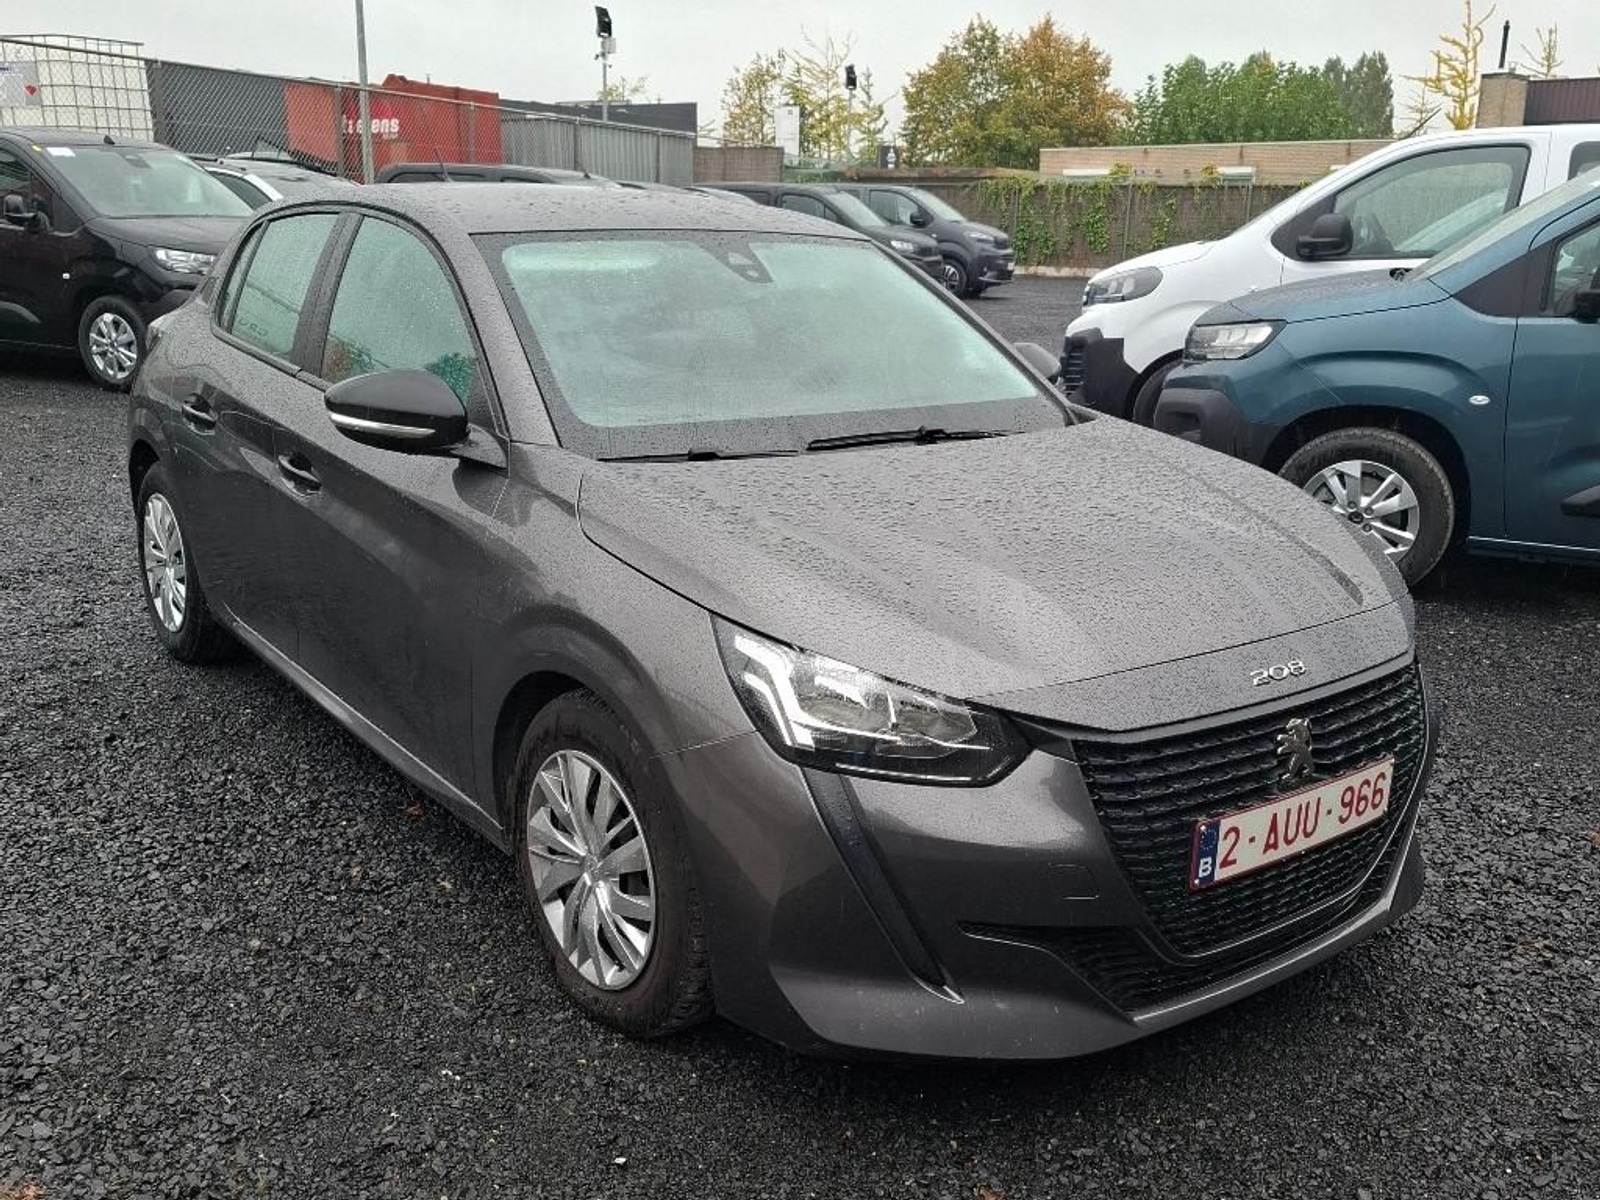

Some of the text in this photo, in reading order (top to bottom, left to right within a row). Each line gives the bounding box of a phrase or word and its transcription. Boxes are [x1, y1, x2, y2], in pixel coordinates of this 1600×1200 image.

[1250, 660, 1306, 686] 208
[1219, 772, 1386, 869] 2-AUU-966
[1199, 857, 1212, 877] B
